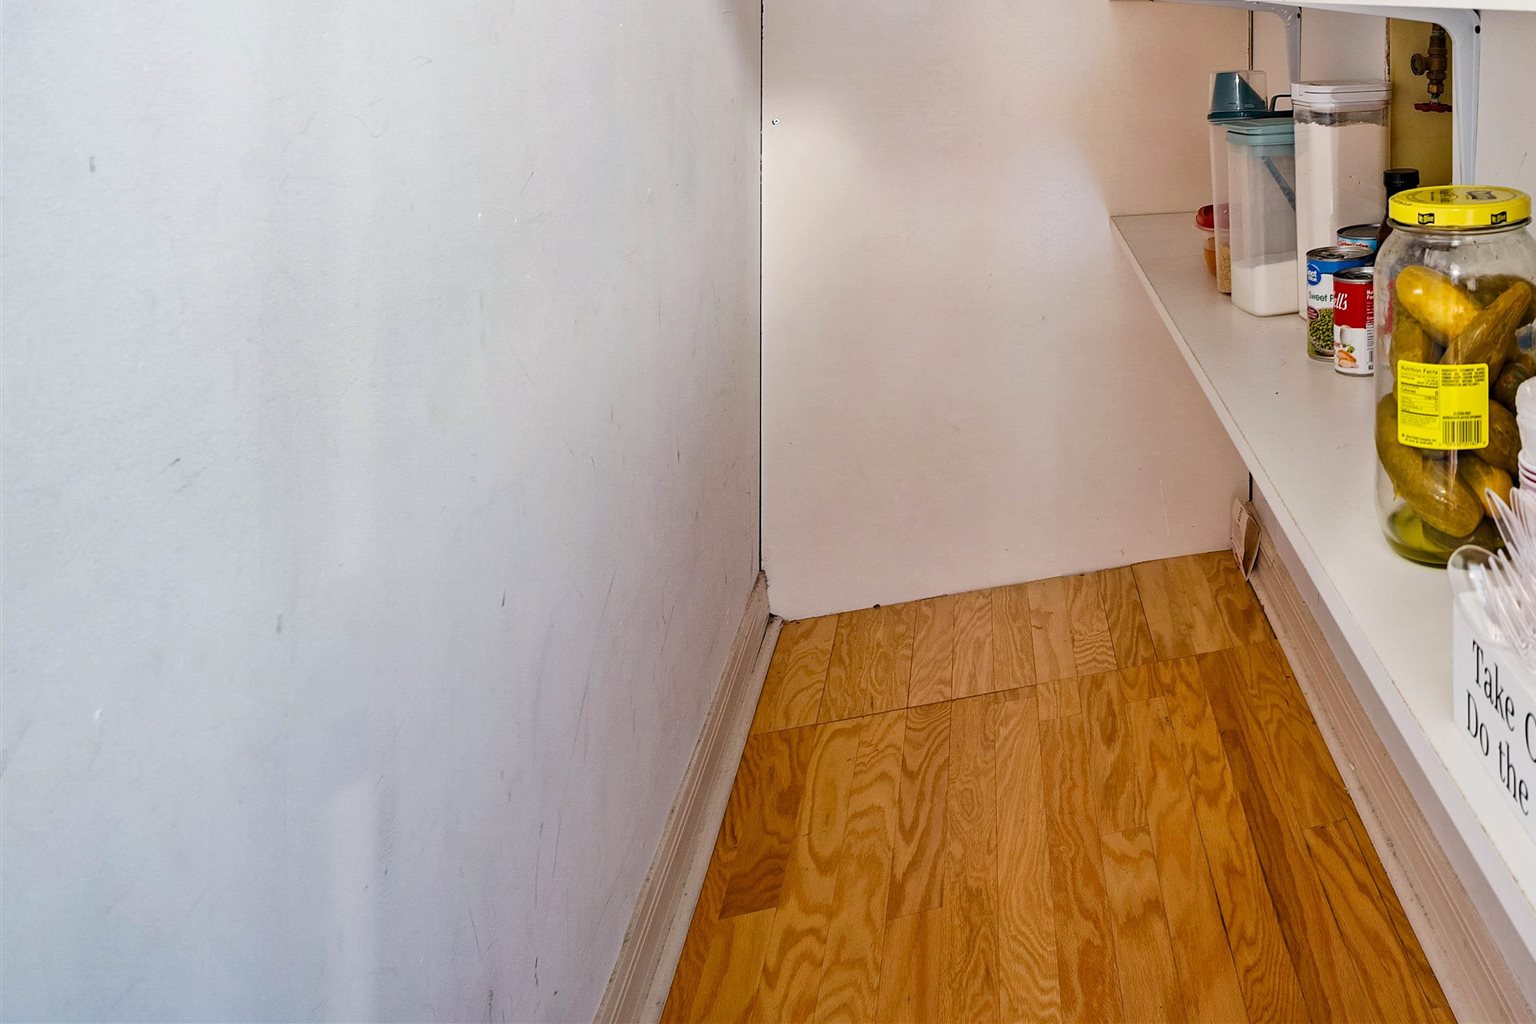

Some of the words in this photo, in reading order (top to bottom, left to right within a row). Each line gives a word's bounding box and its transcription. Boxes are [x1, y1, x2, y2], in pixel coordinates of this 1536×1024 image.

[1308, 291, 1327, 302] Sweet
[1472, 640, 1516, 733] Take
[1466, 689, 1490, 757] Do
[1498, 739, 1530, 817] the
